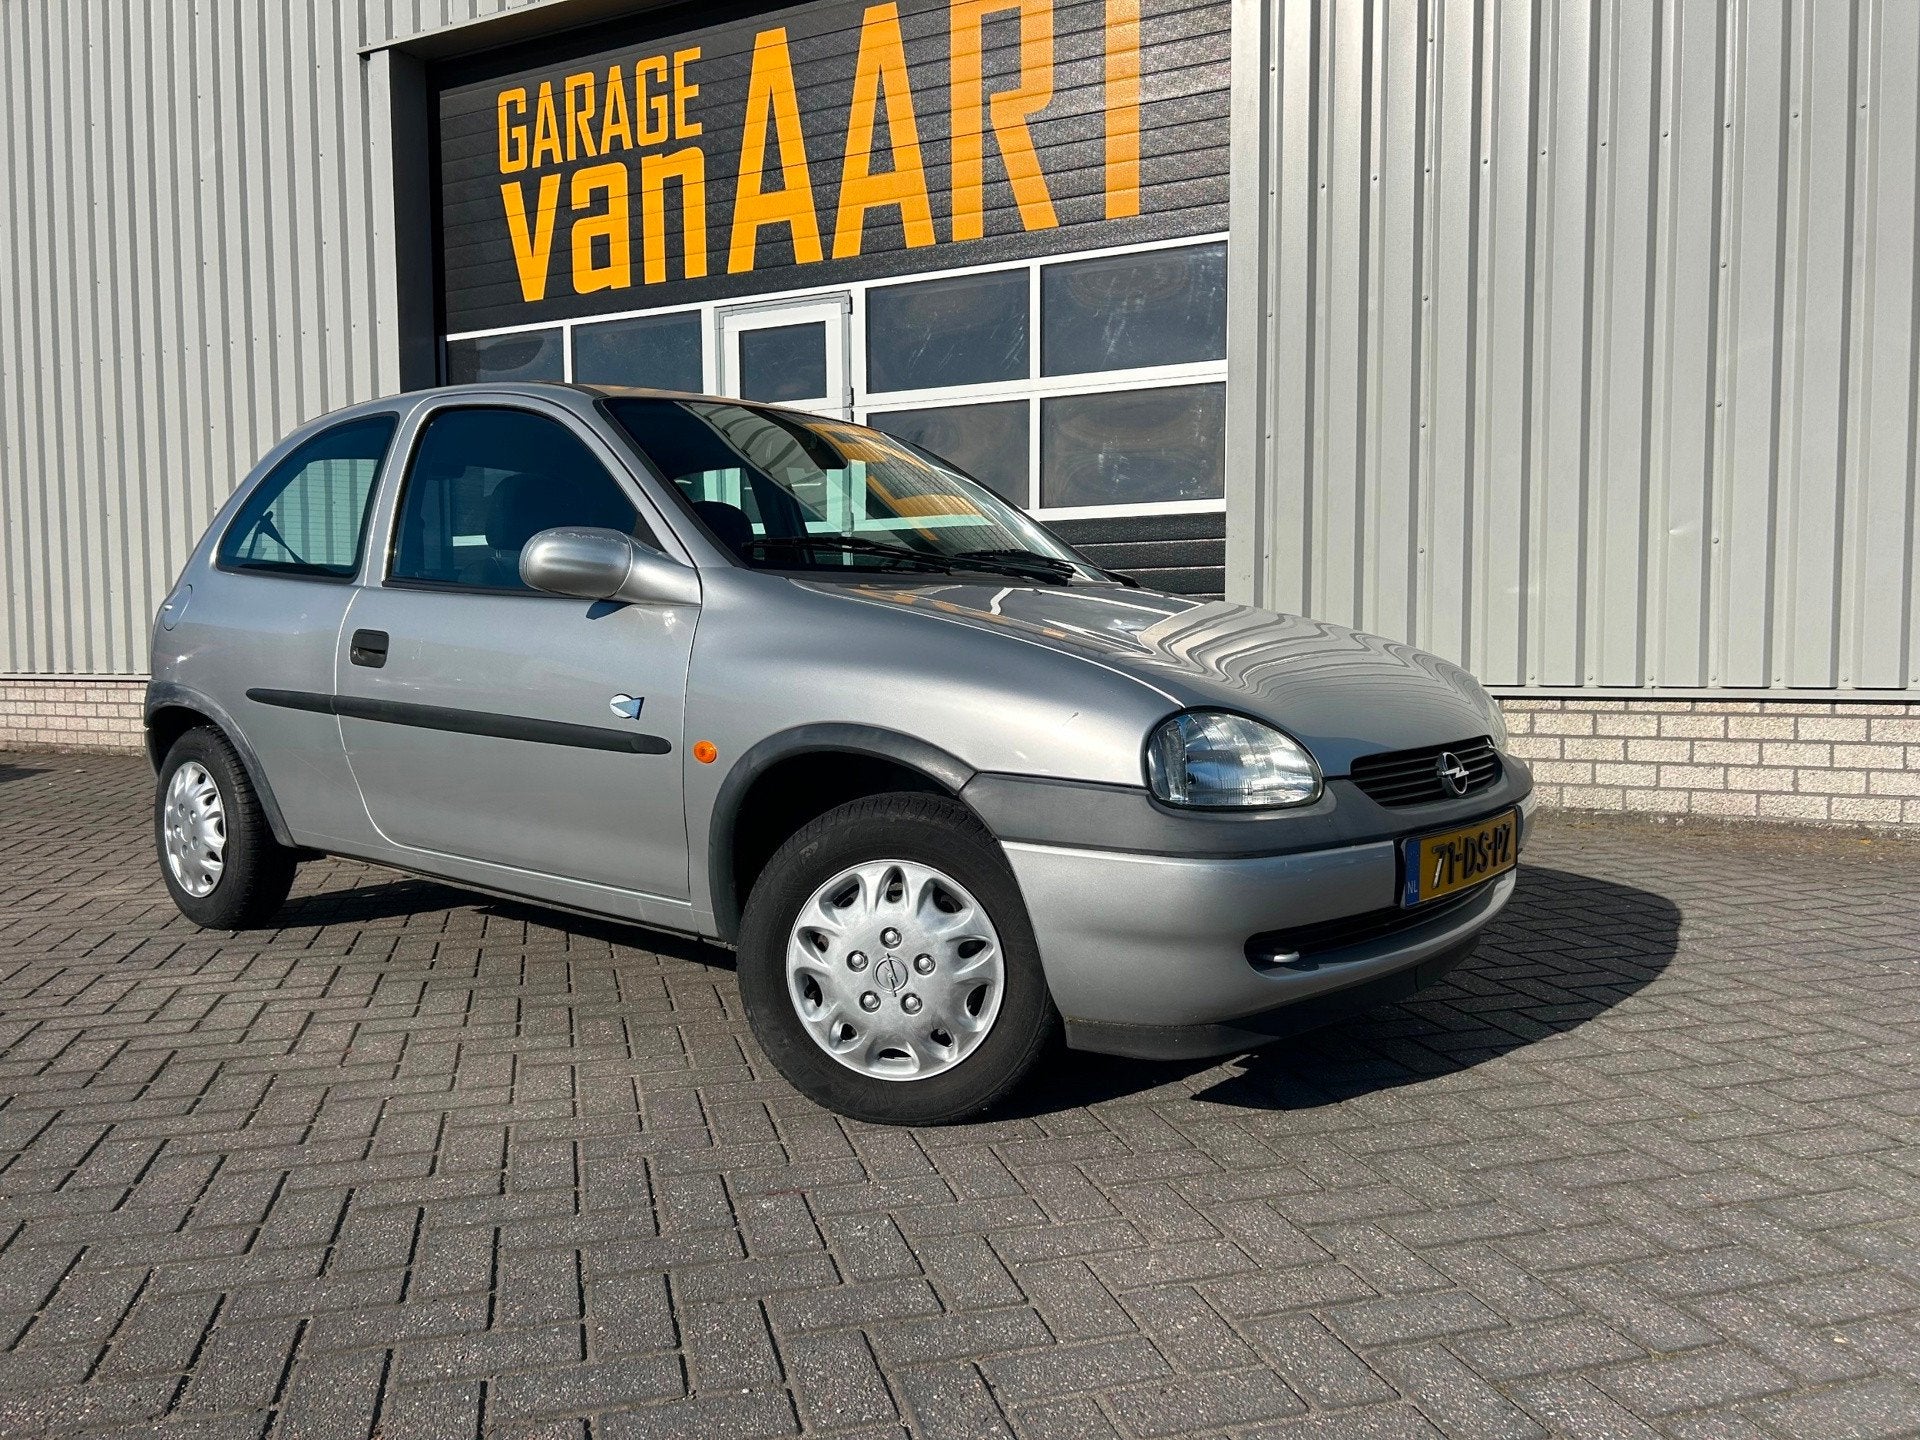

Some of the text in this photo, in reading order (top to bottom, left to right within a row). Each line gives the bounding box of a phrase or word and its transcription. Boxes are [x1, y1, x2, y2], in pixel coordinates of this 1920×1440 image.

[498, 46, 703, 174] GARAGE
[501, 146, 708, 302] van
[1407, 880, 1418, 895] NL
